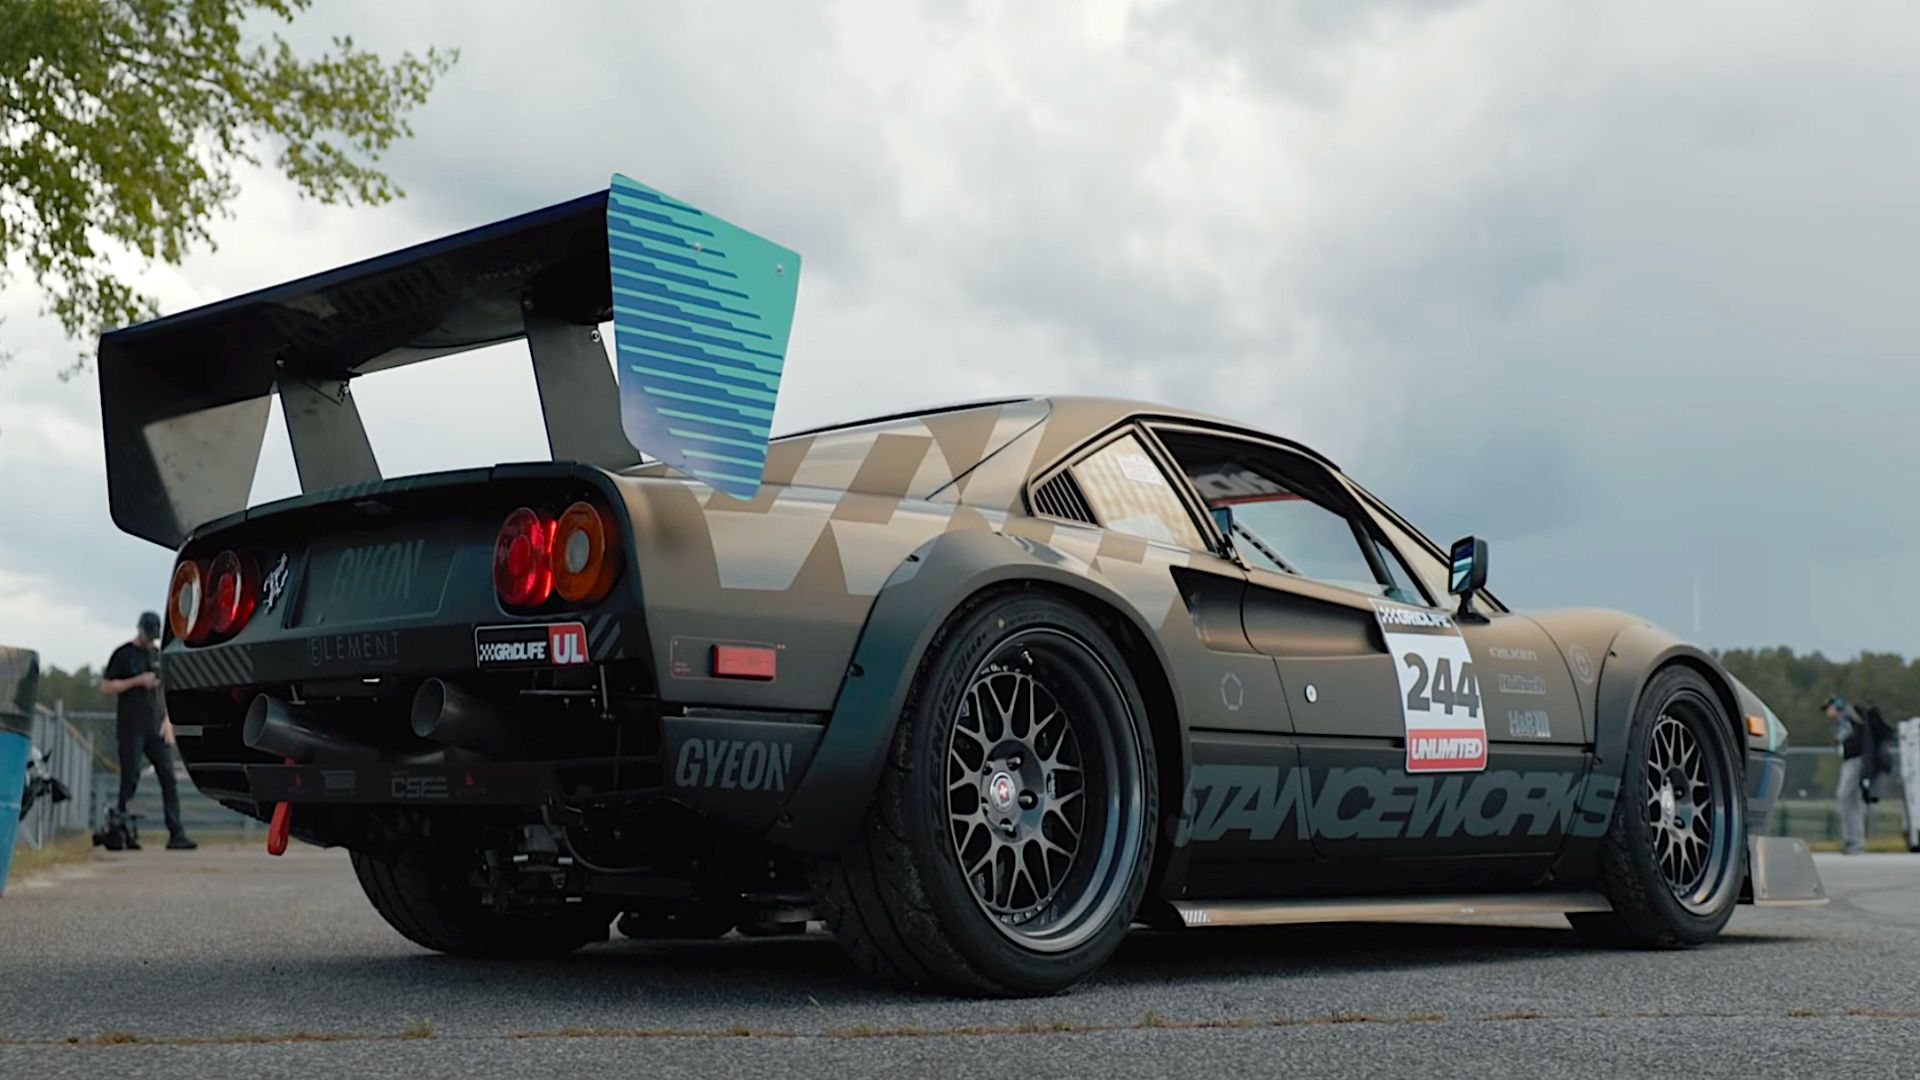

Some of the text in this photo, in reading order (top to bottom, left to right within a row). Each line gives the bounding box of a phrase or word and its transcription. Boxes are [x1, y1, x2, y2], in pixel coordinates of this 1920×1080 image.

[329, 539, 426, 603] GYEON
[306, 631, 400, 667] ELEMENT
[494, 633, 584, 664] GRIDLIFE UL
[1403, 652, 1480, 718] 244
[675, 737, 793, 792] GYEON
[1412, 738, 1483, 760] UNLIMITED
[1173, 764, 1622, 848] STANCEWORKS
